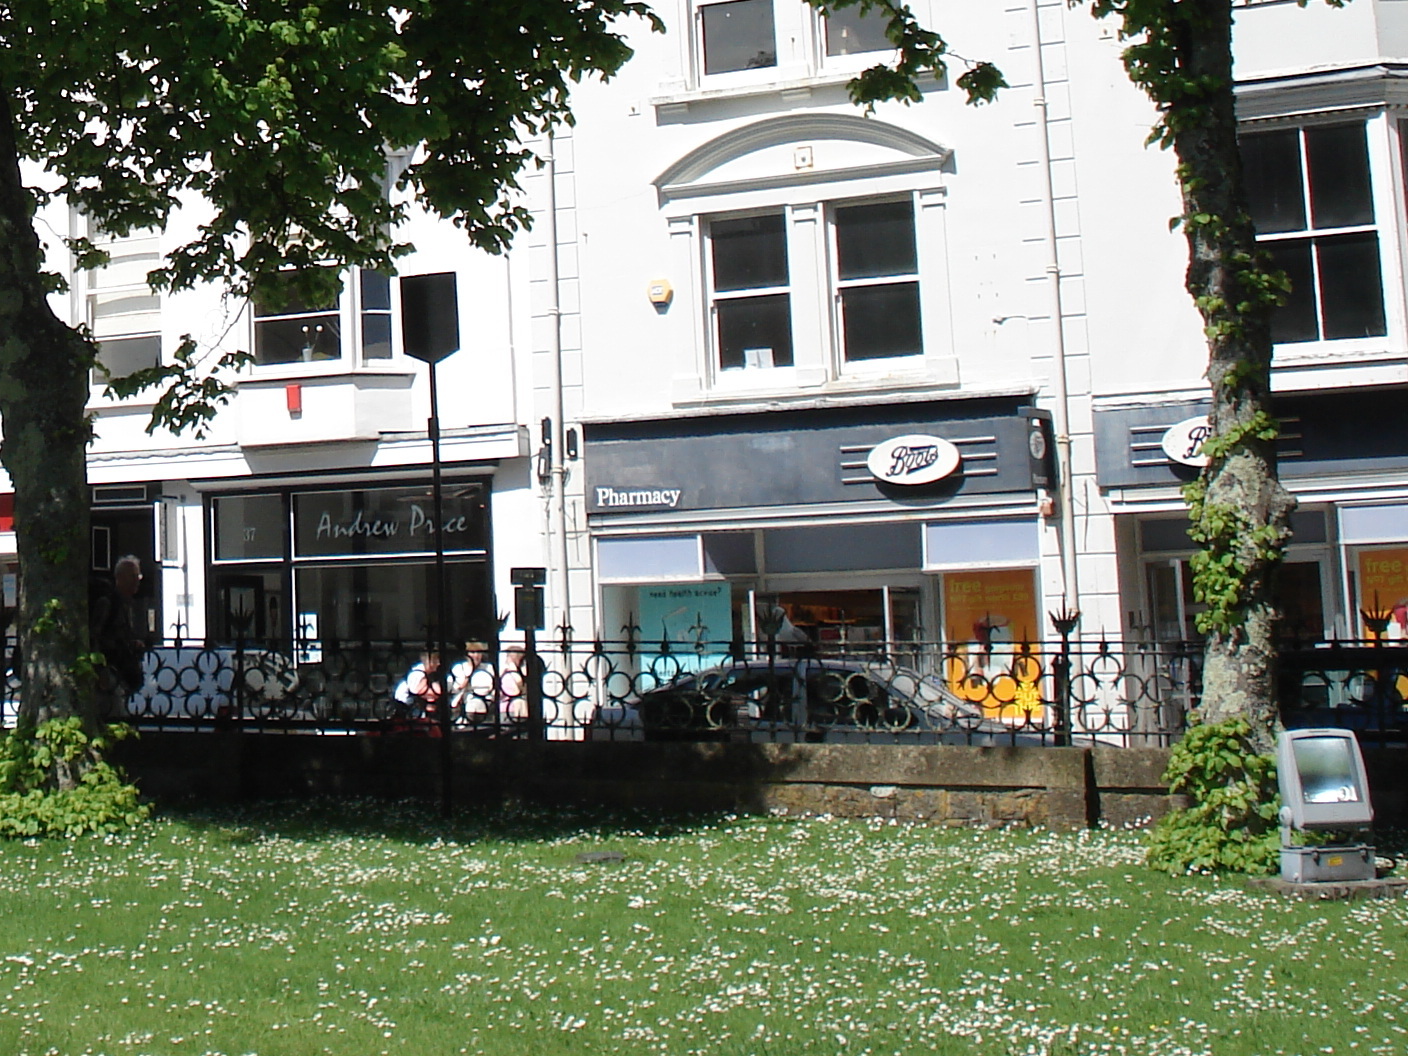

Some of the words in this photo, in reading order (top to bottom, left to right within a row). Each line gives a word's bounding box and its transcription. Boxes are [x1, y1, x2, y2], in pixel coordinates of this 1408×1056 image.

[885, 444, 939, 476] Boots
[596, 487, 681, 507] Pharmacy
[316, 511, 398, 541] Andrew
[410, 504, 468, 537] Prce
[243, 527, 256, 542] 37
[1365, 557, 1402, 574] free
[949, 578, 981, 593] free
